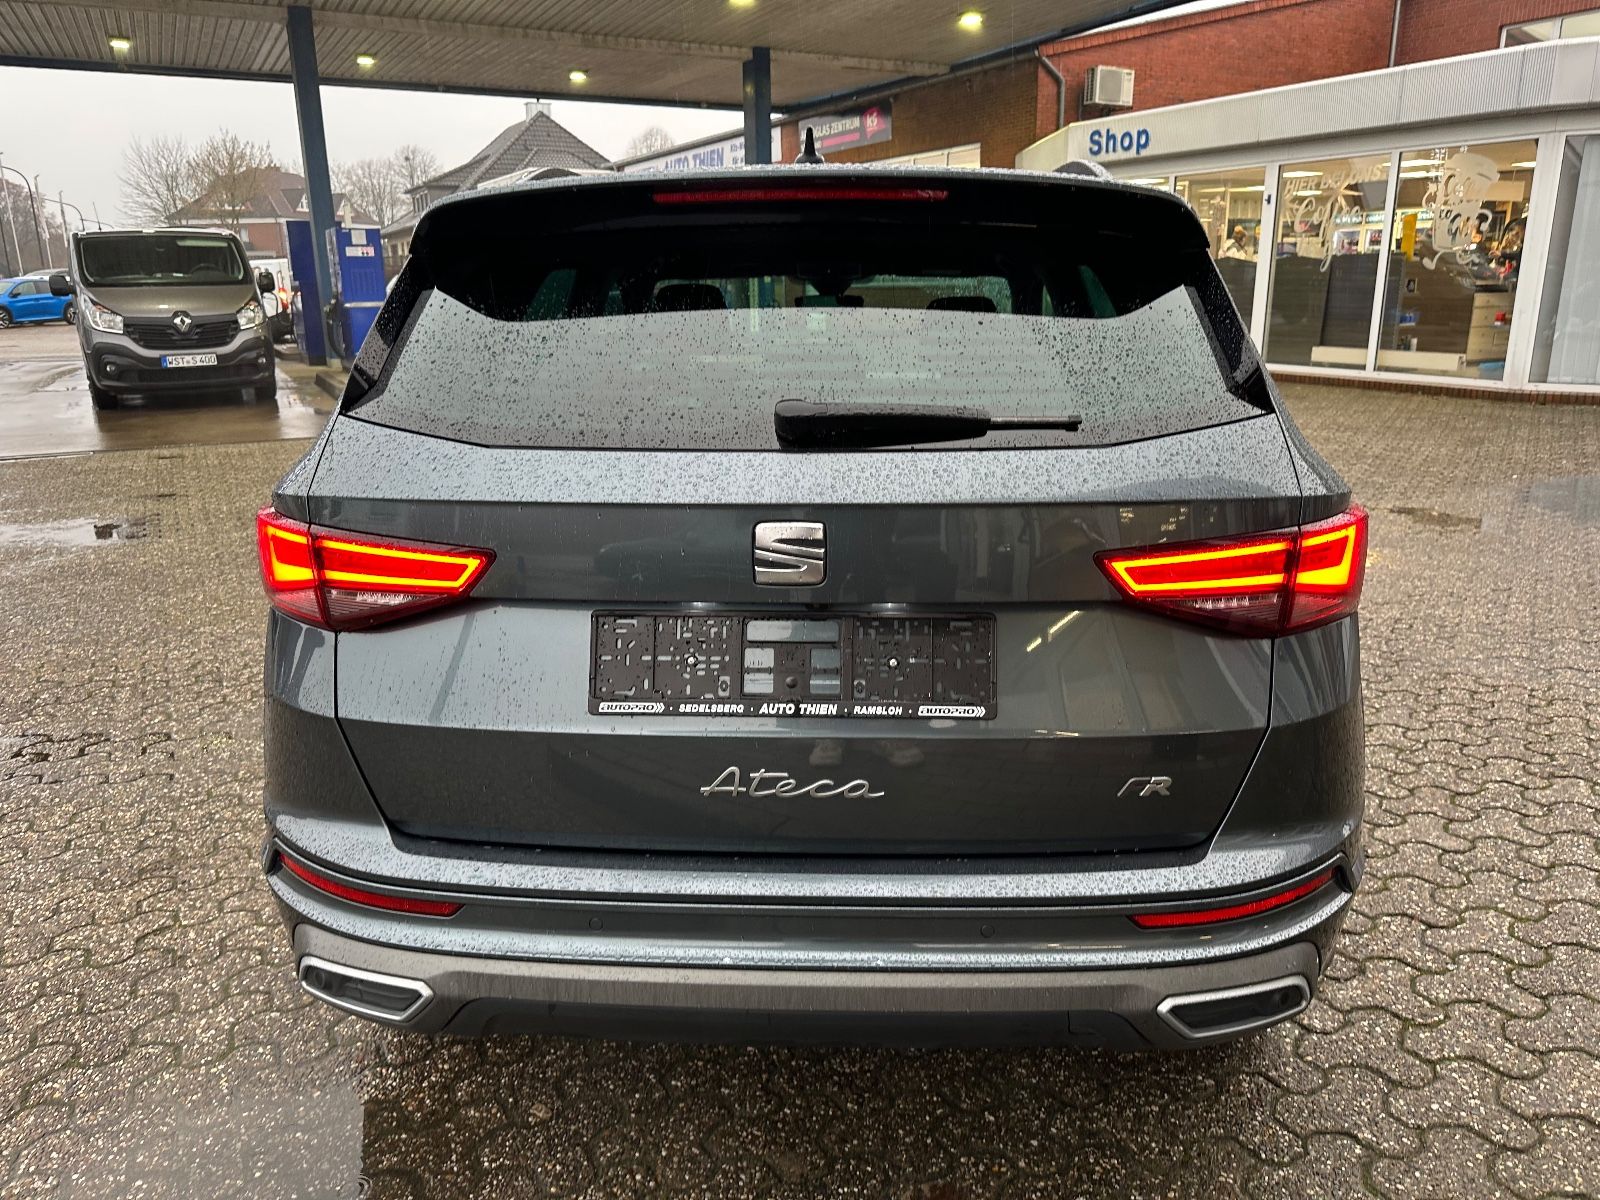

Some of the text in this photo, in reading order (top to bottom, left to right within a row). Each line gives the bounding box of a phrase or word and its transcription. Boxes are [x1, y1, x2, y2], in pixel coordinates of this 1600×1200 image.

[1089, 128, 1150, 155] Shop
[693, 147, 724, 168] THIEN
[1285, 178, 1316, 195] HIER
[199, 354, 216, 364] 400
[679, 703, 744, 713] SEDELSBERG
[759, 703, 795, 714] AUTO
[799, 703, 838, 715] THIEN
[853, 705, 903, 716] RAMSLOH
[700, 766, 885, 798] Ateca
